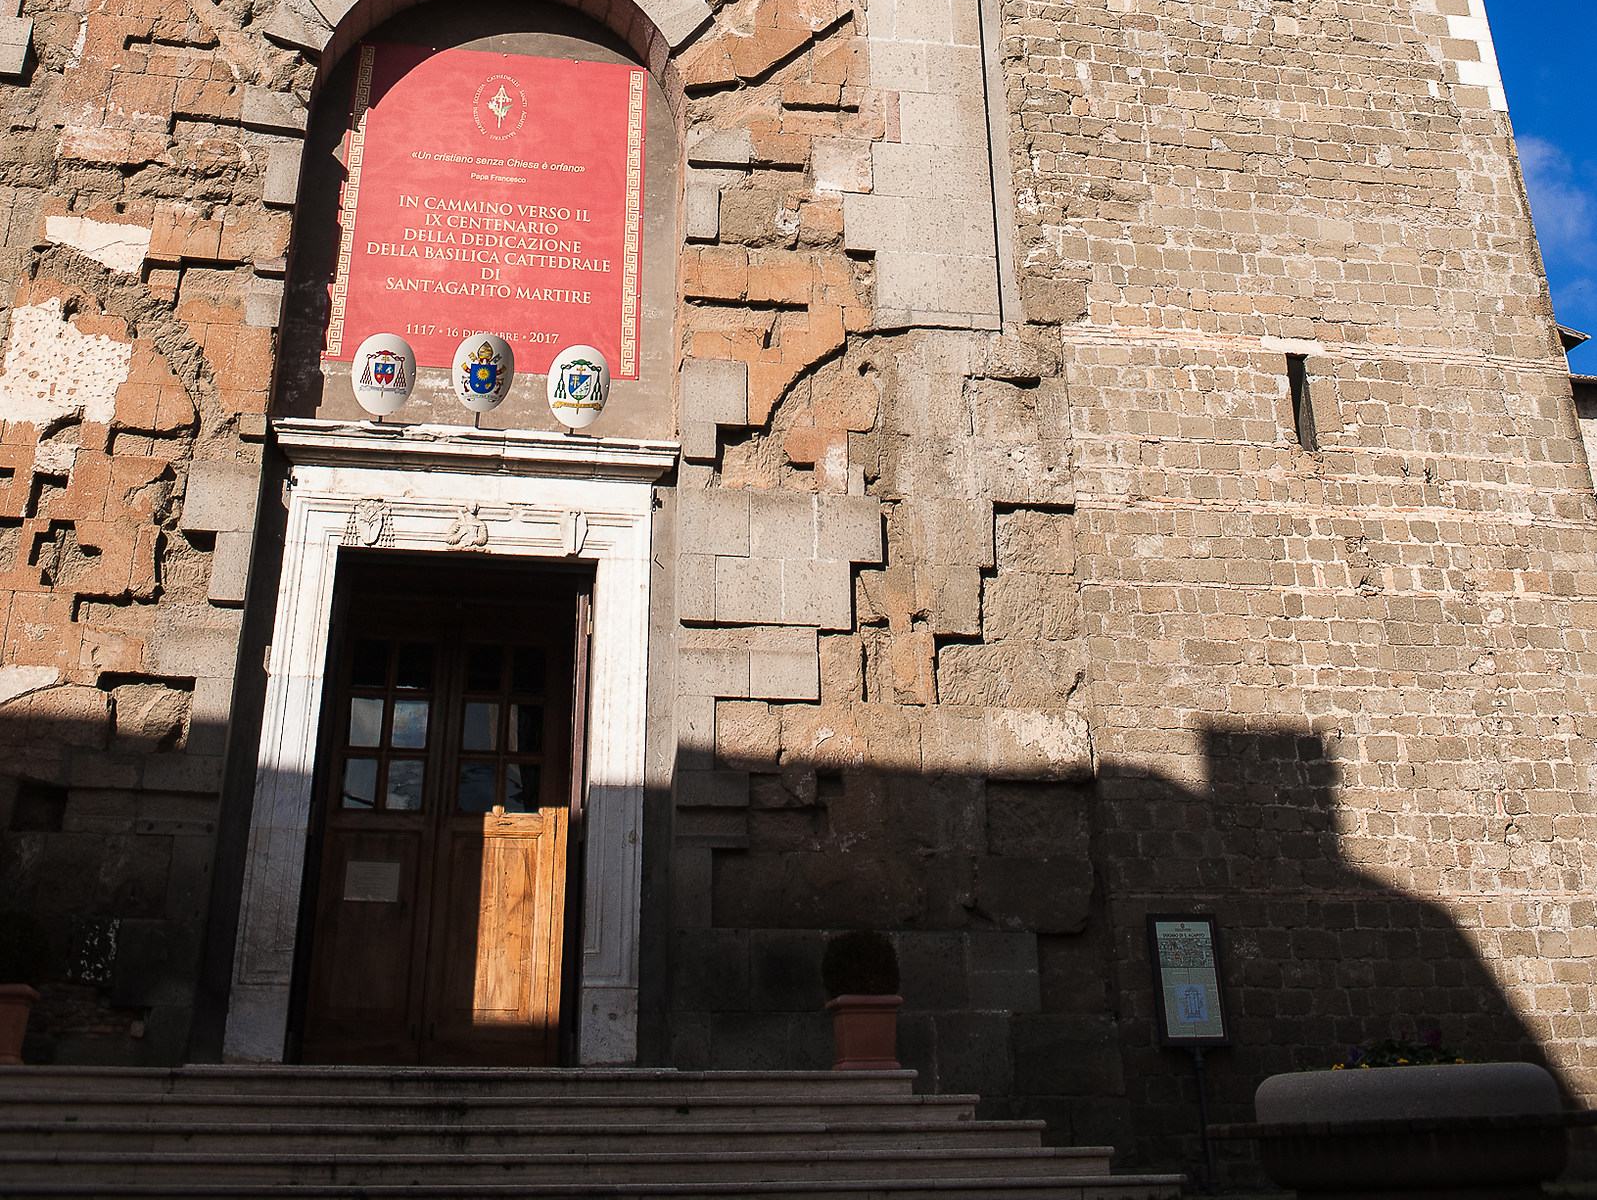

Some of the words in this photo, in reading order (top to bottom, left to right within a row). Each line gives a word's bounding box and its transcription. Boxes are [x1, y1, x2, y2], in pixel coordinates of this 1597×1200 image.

[411, 151, 431, 160] «Un
[434, 153, 474, 164] cristiano
[475, 156, 504, 166] senza
[507, 158, 539, 169] Chiesa
[541, 161, 548, 170] è
[550, 163, 585, 173] orfano»
[470, 173, 489, 181] Papa
[490, 174, 526, 184] Francesco
[399, 195, 419, 208] IN
[424, 197, 513, 216] CAMMINO
[517, 205, 571, 220] VERSO
[576, 209, 591, 222] IL
[425, 213, 442, 226] IX
[447, 215, 559, 235] CENTENARIO
[404, 228, 456, 244] DELLA
[461, 232, 581, 254] DEDICAZIONE
[366, 242, 420, 257] DELLA
[424, 246, 500, 264] BASILICA
[504, 252, 611, 273] CATTEDRALE
[481, 267, 500, 280] DI
[385, 277, 511, 298] SANT'AGAPITO
[515, 286, 591, 304] MARTIRE
[405, 323, 436, 335] 1117
[446, 327, 459, 338] 16
[529, 331, 560, 344] 2017
